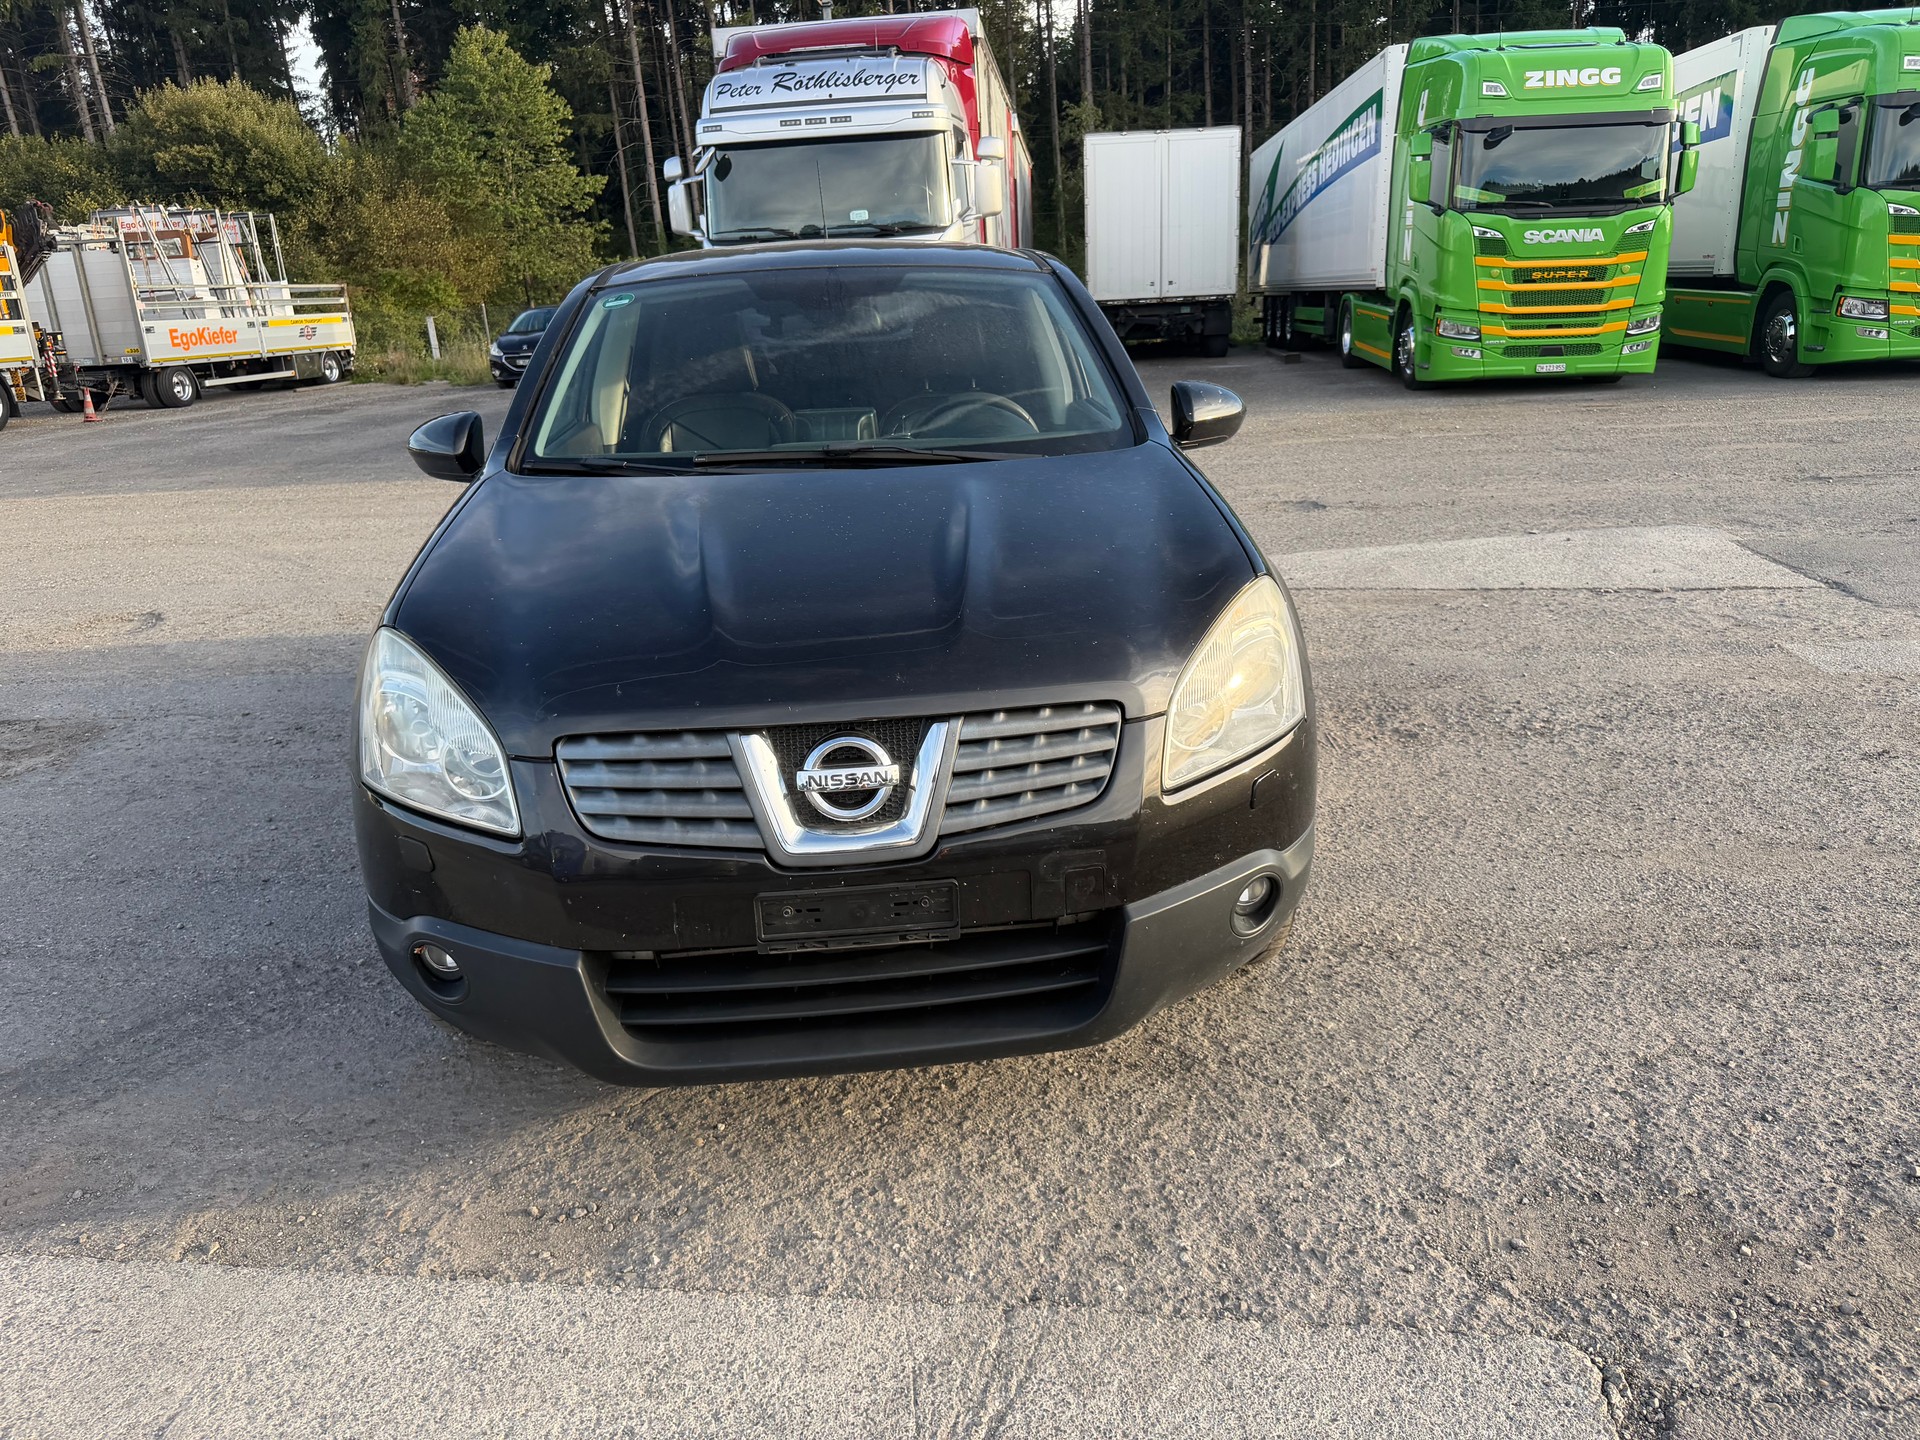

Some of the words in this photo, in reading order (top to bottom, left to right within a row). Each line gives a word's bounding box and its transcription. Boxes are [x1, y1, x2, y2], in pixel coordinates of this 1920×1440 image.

[715, 82, 763, 100] Peter
[771, 68, 921, 94] Röthlisberger
[1524, 67, 1621, 89] ZINGG
[1318, 103, 1377, 185] HEDINGEN
[1771, 67, 1816, 246] ZINGG
[1523, 228, 1605, 245] SCANIA
[1531, 270, 1589, 279] SUPER
[168, 326, 238, 351] EgoKiefer
[807, 770, 889, 789] NISSAN
